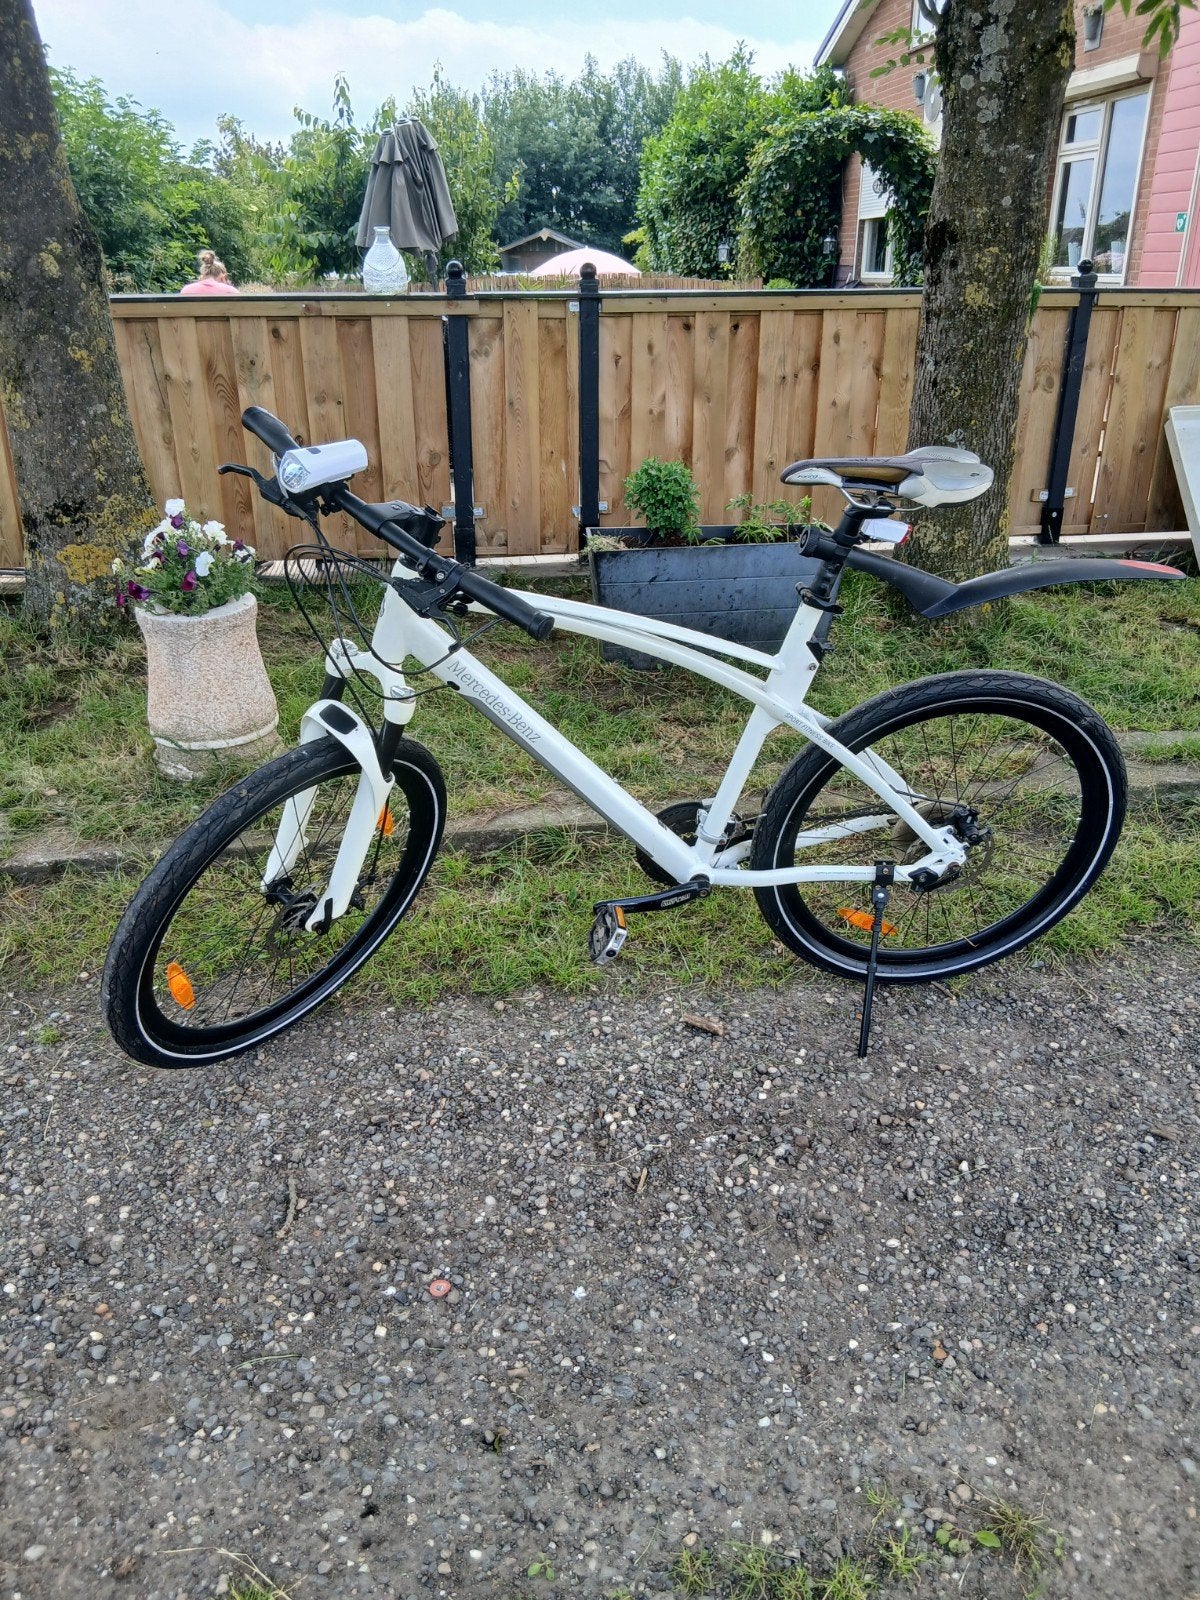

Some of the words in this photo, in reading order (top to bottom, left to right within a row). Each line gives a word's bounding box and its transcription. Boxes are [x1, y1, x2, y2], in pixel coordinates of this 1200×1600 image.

[447, 660, 541, 743] Mercedes-Benz
[784, 712, 803, 727] SPORT
[801, 724, 824, 741] FITNESS
[821, 738, 836, 749] BIKE
